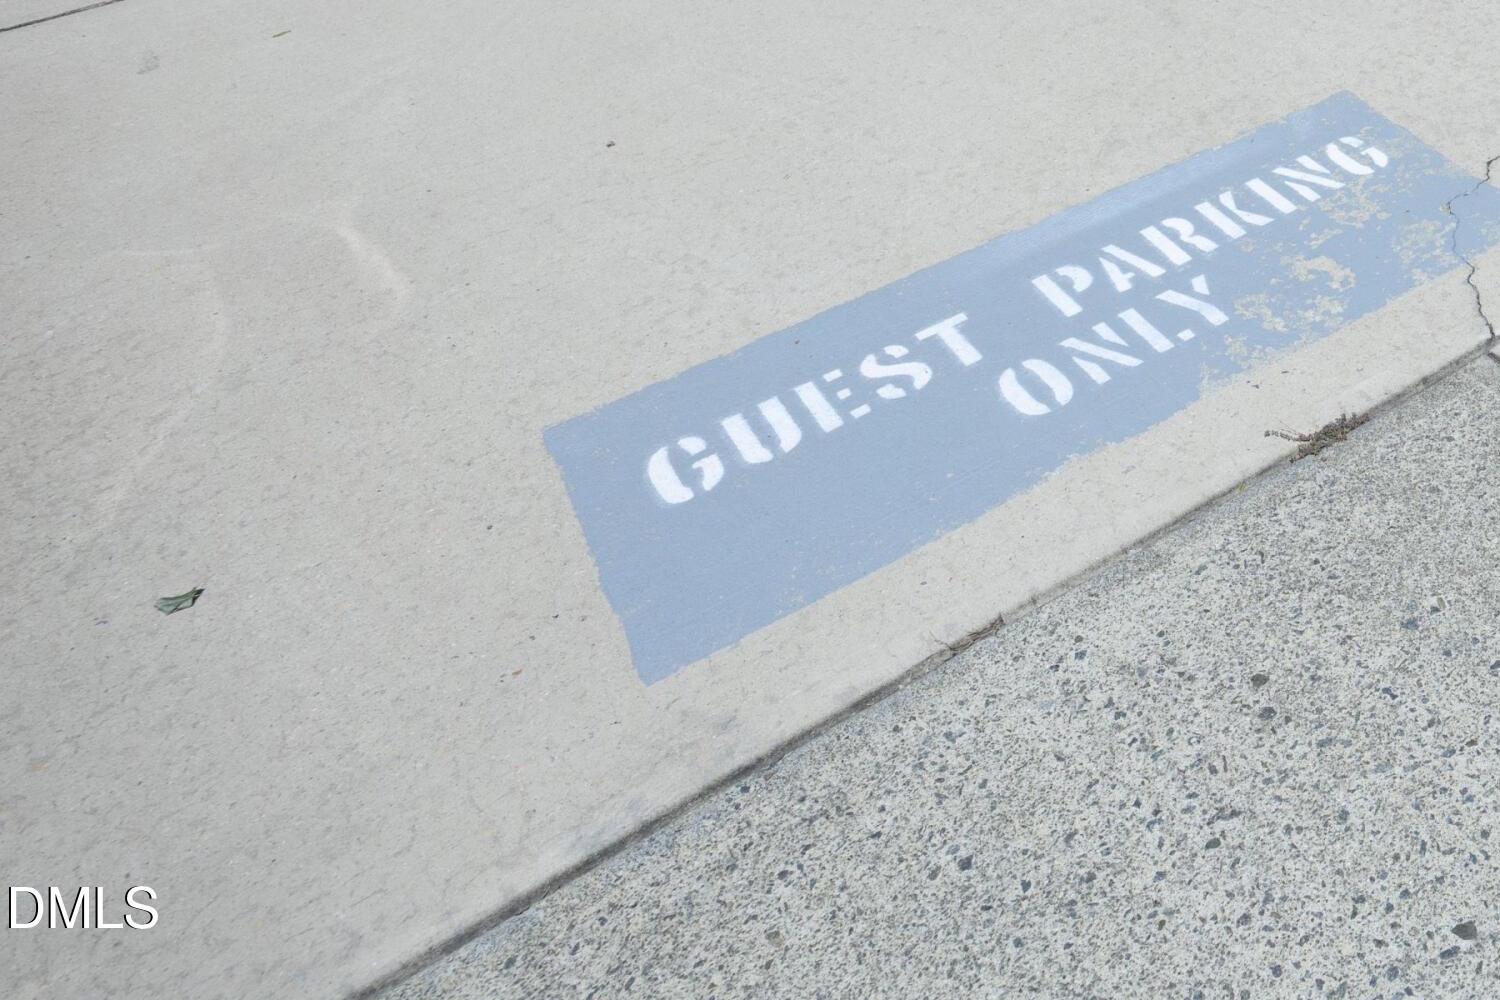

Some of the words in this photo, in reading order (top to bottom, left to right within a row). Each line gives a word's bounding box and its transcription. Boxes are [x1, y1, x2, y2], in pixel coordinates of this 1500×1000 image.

[647, 312, 983, 505] GUEST
[1031, 135, 1389, 318] PARKING
[998, 274, 1229, 416] ONLY
